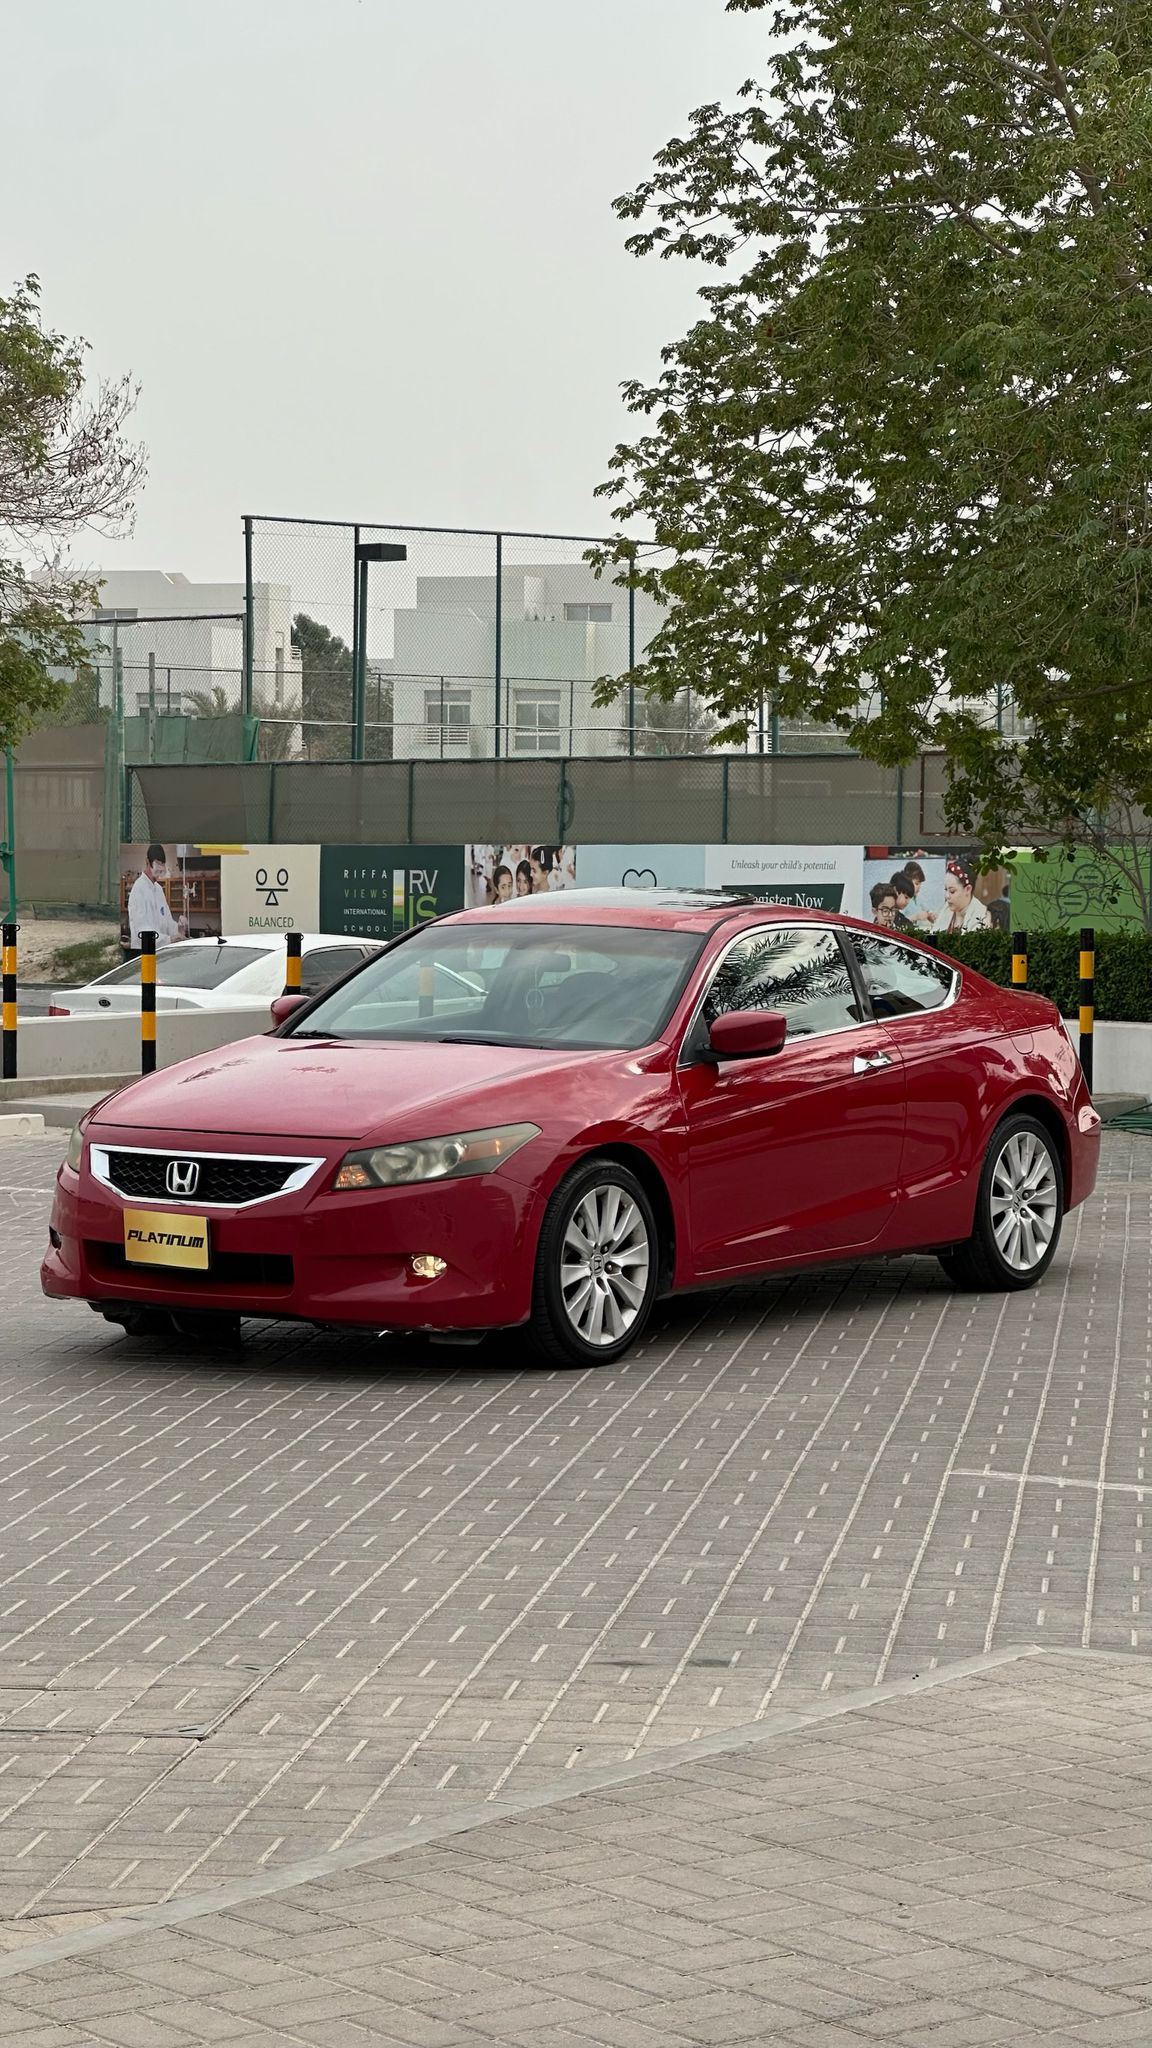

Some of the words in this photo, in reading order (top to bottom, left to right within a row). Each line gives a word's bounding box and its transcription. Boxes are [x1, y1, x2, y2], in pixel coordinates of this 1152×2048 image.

[731, 860, 759, 869] Unleash
[761, 862, 778, 871] your
[780, 860, 802, 869] child's
[803, 860, 836, 871] potential
[343, 869, 388, 879] RIFFA
[409, 869, 439, 894] RV
[344, 889, 388, 899] VIEWS
[795, 893, 824, 908] Now
[343, 908, 388, 916] INTERNATIONAL
[248, 916, 295, 928] BALANCED
[343, 924, 388, 932] SCHOOL
[127, 1229, 205, 1249] PLATINUM
